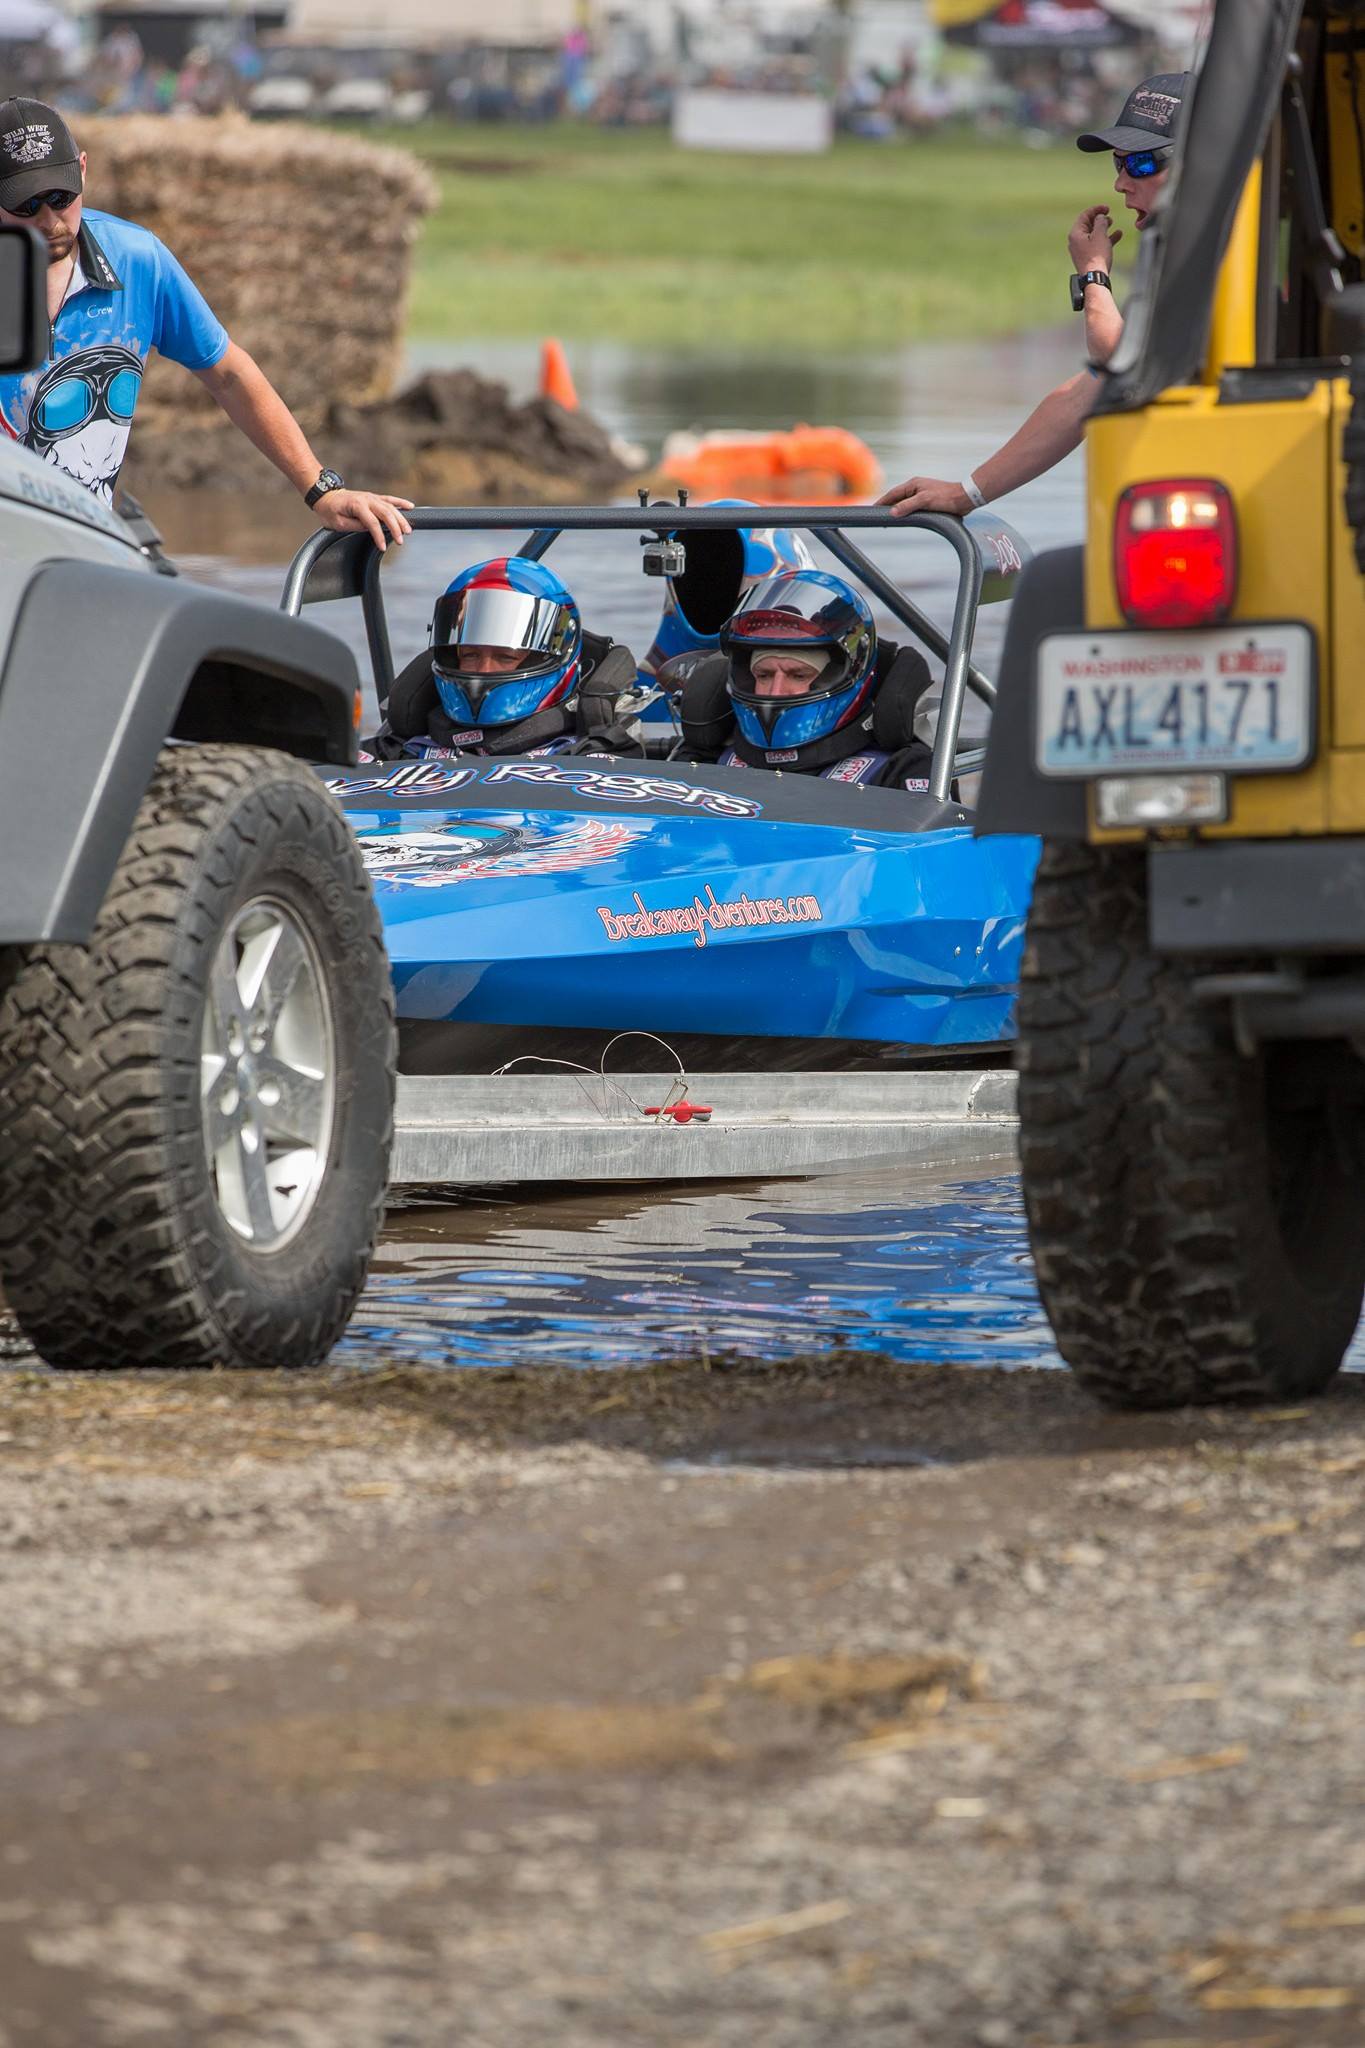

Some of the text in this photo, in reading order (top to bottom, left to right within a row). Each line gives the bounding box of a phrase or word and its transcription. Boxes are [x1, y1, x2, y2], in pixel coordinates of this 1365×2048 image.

[3, 128, 25, 140] WILD
[87, 305, 113, 318] Crew
[1061, 654, 1204, 677] WASHINGTON
[1056, 679, 1280, 749] AXL4171
[322, 762, 763, 817] olly Rogers
[596, 884, 823, 948] BreakawayAdventures.com
